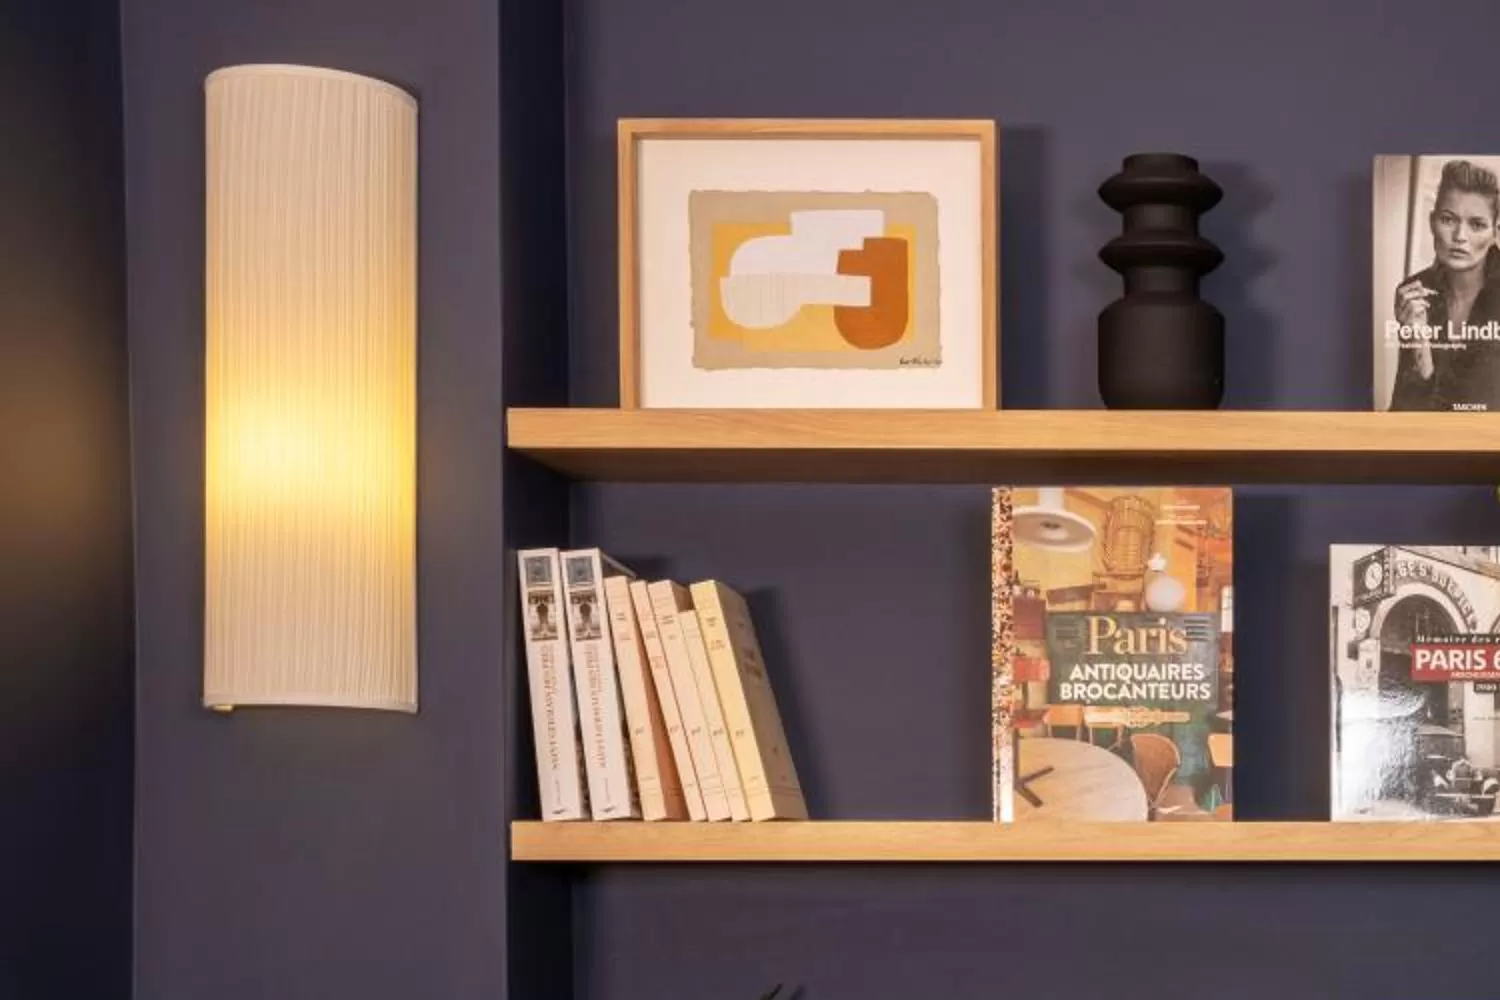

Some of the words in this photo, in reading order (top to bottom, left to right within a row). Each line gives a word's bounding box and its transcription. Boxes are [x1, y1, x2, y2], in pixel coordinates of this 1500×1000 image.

[1384, 320, 1442, 339] Peter
[1084, 615, 1189, 656] Paris
[1415, 649, 1487, 670] PARIS
[1069, 663, 1205, 683] ANTIQUAIRES
[1059, 682, 1212, 702] BROCANTEURS
